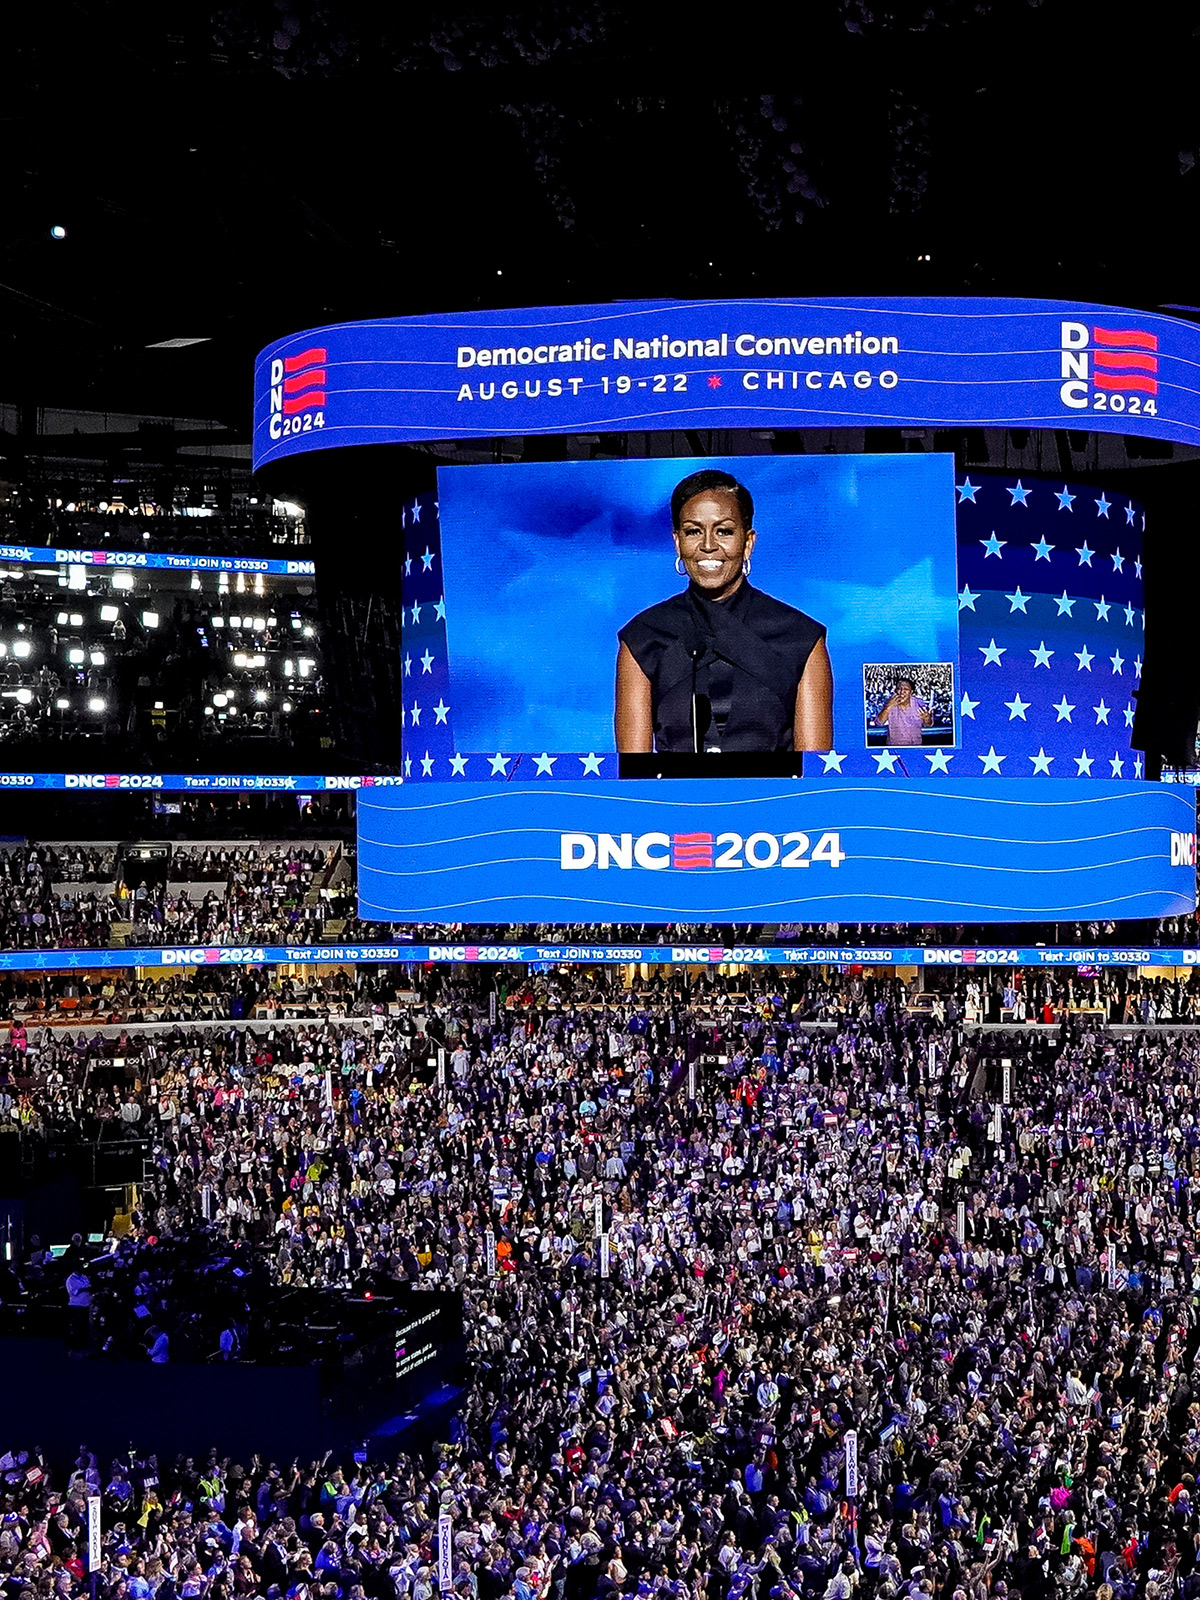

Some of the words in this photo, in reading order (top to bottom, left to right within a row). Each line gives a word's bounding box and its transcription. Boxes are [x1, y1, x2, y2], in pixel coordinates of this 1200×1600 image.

[457, 338, 606, 368] Democratic
[613, 334, 728, 360] National
[735, 331, 899, 356] Convention
[1060, 321, 1089, 409] DNC
[270, 358, 283, 439] DNC
[457, 377, 584, 401] AUGUST
[601, 374, 688, 394] 19-22
[742, 371, 899, 390] CHICAGO
[1093, 393, 1158, 417] 2024
[283, 411, 325, 436] 2024
[56, 550, 93, 563] DNC
[106, 552, 147, 565] 2024
[166, 557, 190, 566] Text
[192, 558, 219, 568] JOIN
[221, 559, 232, 568] to
[234, 560, 269, 570] 30330
[65, 775, 105, 787] DNC
[119, 776, 164, 788] 2024
[184, 777, 209, 787] Text
[211, 777, 240, 787] JOIN
[242, 777, 254, 787] to
[325, 777, 361, 789] DNC
[560, 833, 670, 869] DNC
[716, 832, 845, 869] 2024
[162, 950, 205, 963] DNC
[220, 949, 264, 963] 2024
[285, 950, 311, 960] Text
[313, 949, 344, 959] JOIN
[346, 949, 358, 959] to
[360, 949, 399, 959] 30330
[429, 947, 465, 960] DNC
[478, 947, 517, 960] 2024
[537, 949, 560, 958] Text
[562, 949, 588, 959] JOIN
[592, 949, 603, 959] to
[606, 949, 641, 959] 30330
[672, 948, 710, 961] DNC
[723, 948, 764, 961] 2024
[784, 951, 808, 960] Text
[809, 951, 838, 960] JOIN
[840, 951, 853, 960] to
[854, 950, 892, 960] 30330
[924, 950, 962, 963] DNC
[976, 950, 1019, 963] 2024
[1038, 952, 1064, 962] Text
[1066, 952, 1092, 962] JOIN
[1098, 952, 1110, 962] to
[1111, 951, 1150, 962] 30330
[848, 1440, 856, 1487] DELAWARE
[441, 1525, 449, 1580] MINNESOTA
